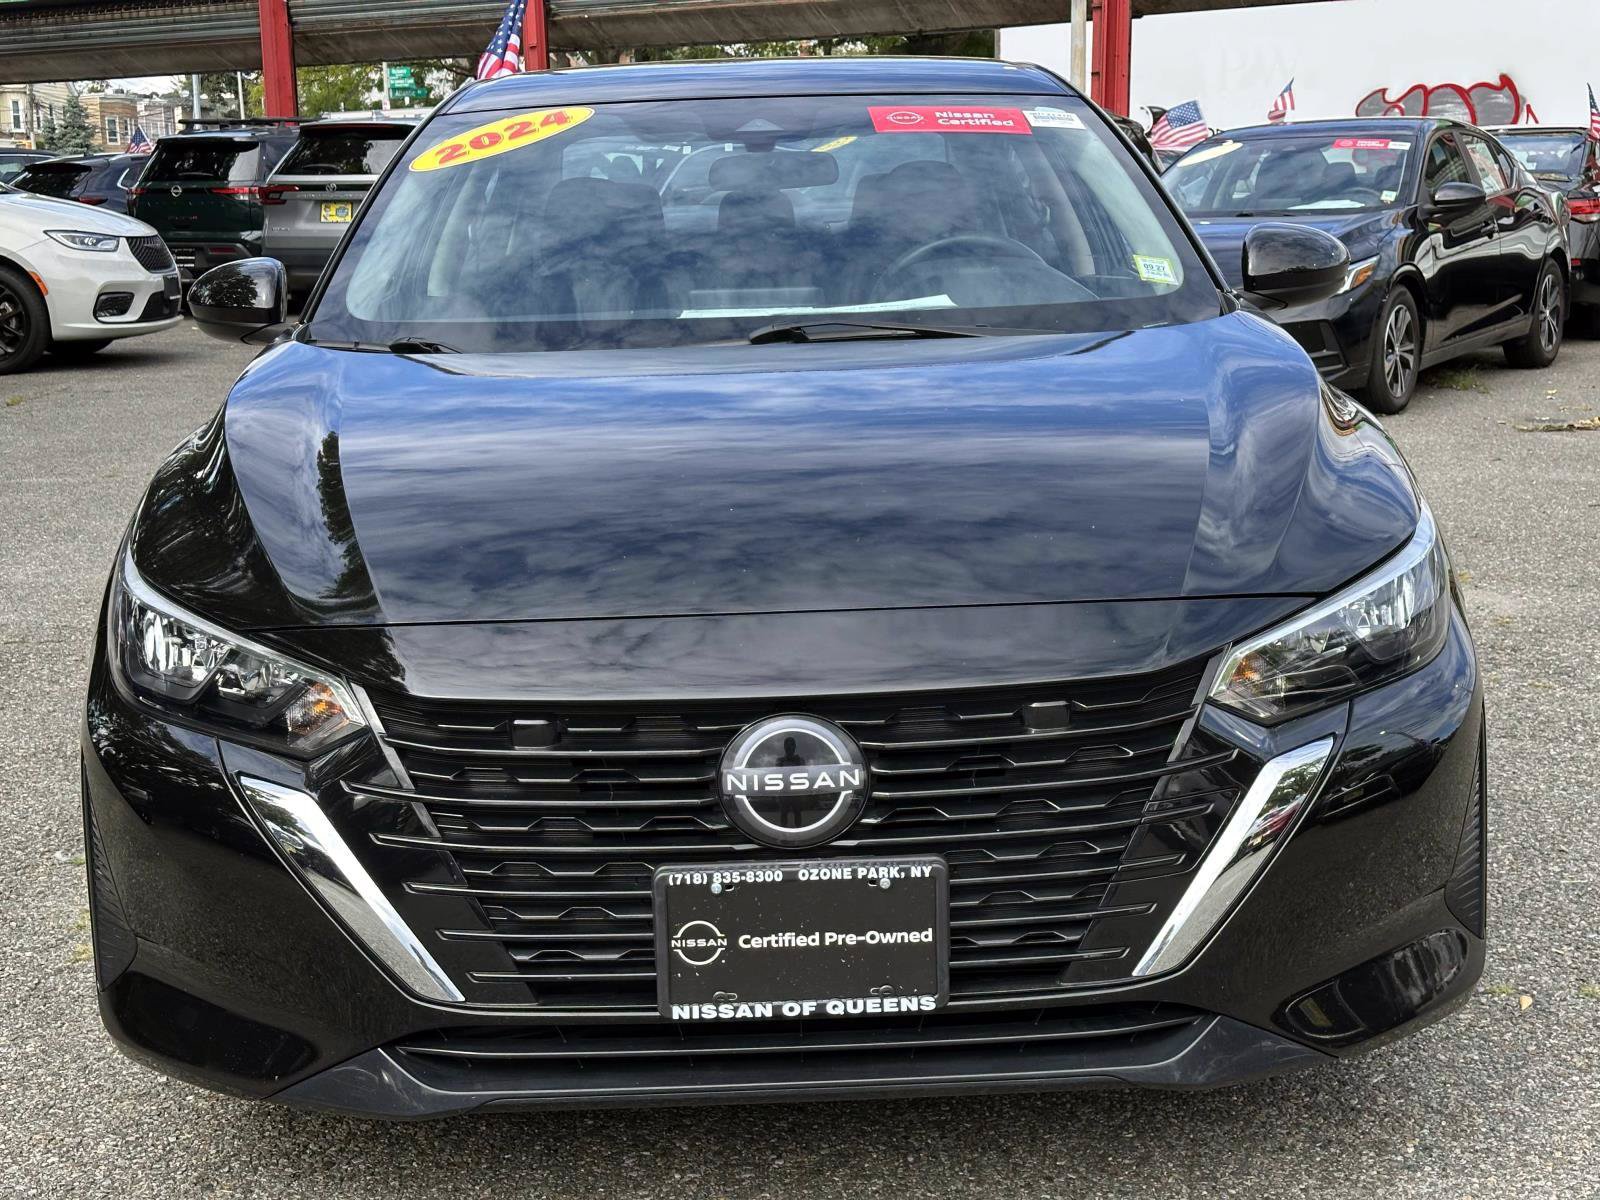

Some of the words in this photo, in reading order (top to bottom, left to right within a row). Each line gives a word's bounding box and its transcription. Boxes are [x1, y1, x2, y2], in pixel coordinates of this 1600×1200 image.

[934, 110, 995, 119] Nissan
[938, 118, 1014, 127] Certified
[434, 111, 571, 165] 2024
[727, 770, 860, 791] NISSAN
[668, 872, 708, 886] (718)
[712, 870, 783, 884] 835-8300
[798, 868, 852, 881] OZONE
[857, 867, 905, 881] PARK,
[911, 866, 932, 878] NY
[671, 938, 728, 949] NISSAN
[738, 931, 820, 950] Certified
[825, 927, 933, 946] Pre-Owned
[672, 1003, 774, 1020] NISSAN
[781, 1000, 818, 1016] OF
[825, 996, 936, 1015] QUEENS
